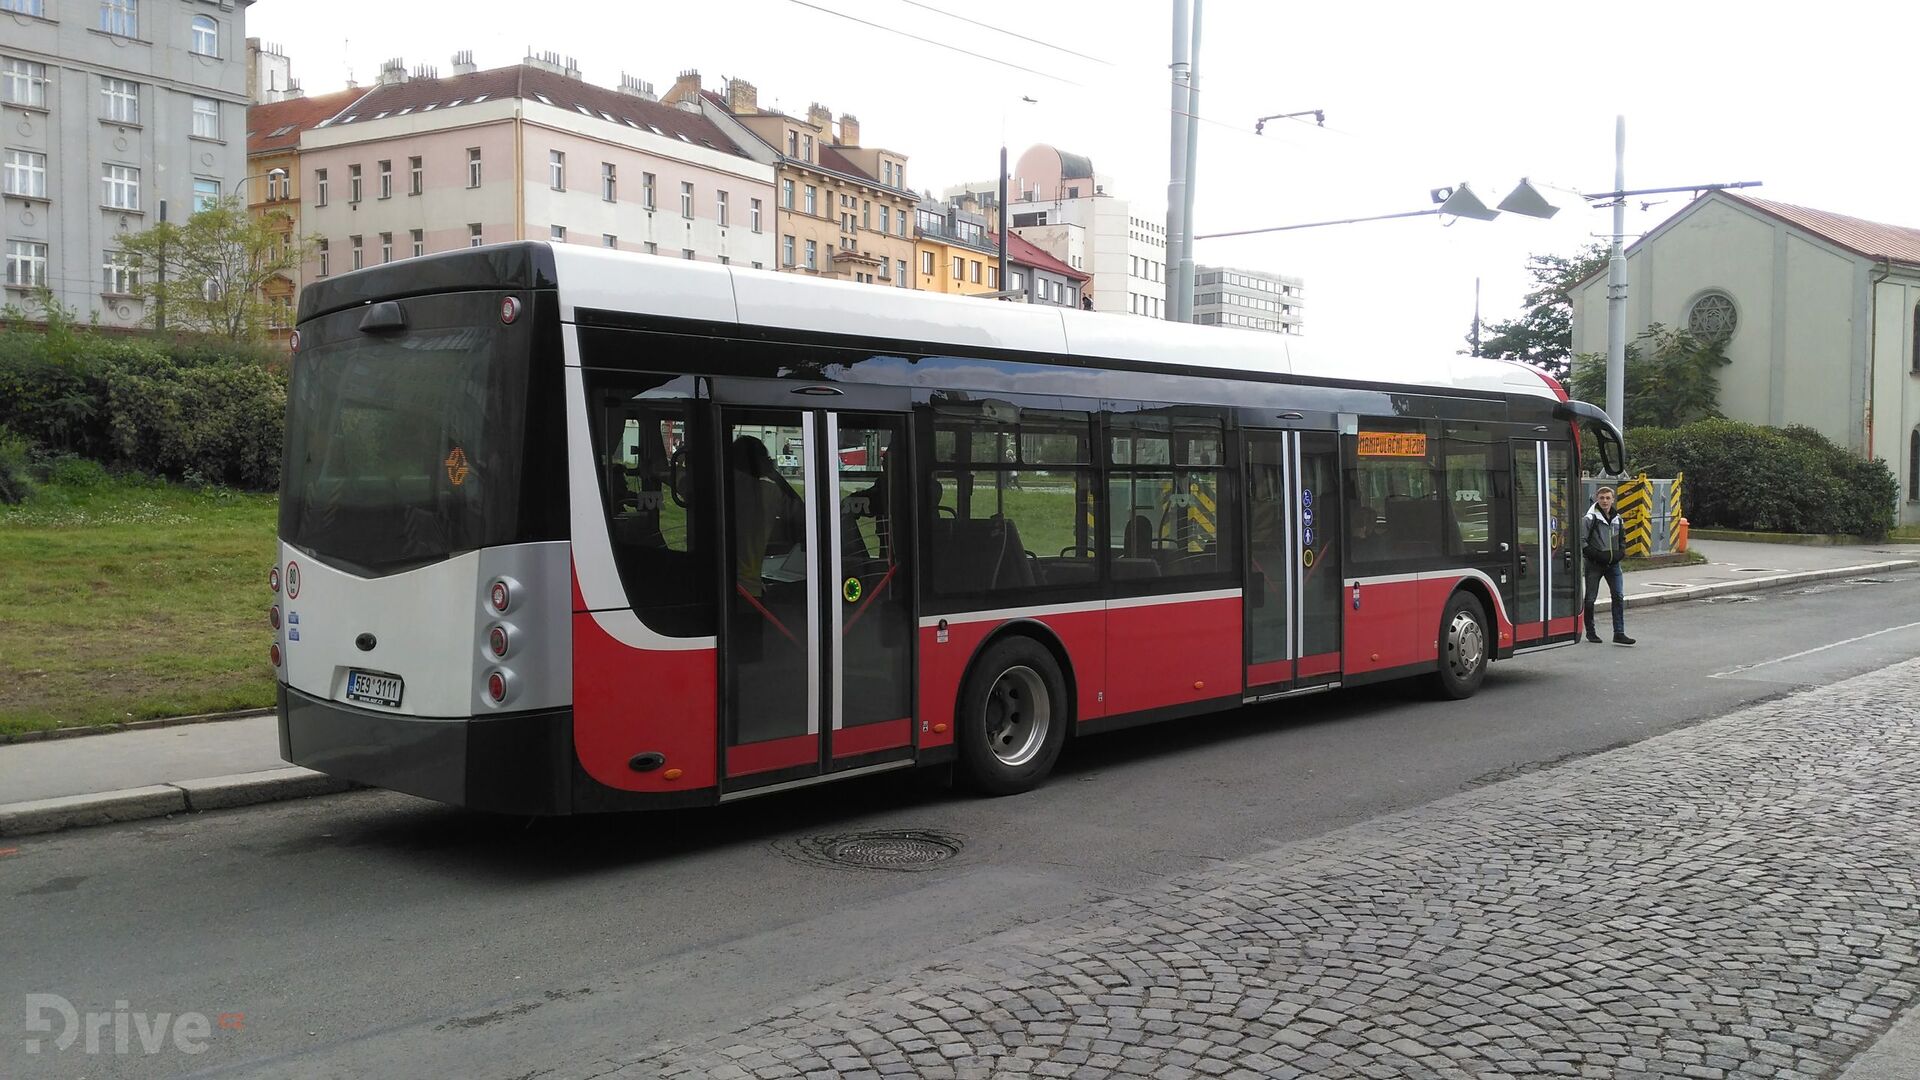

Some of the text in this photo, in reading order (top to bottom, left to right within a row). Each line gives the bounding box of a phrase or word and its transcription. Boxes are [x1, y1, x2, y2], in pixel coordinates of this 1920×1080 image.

[289, 568, 296, 584] 80
[355, 675, 371, 694] 5E9
[375, 678, 397, 698] 3111
